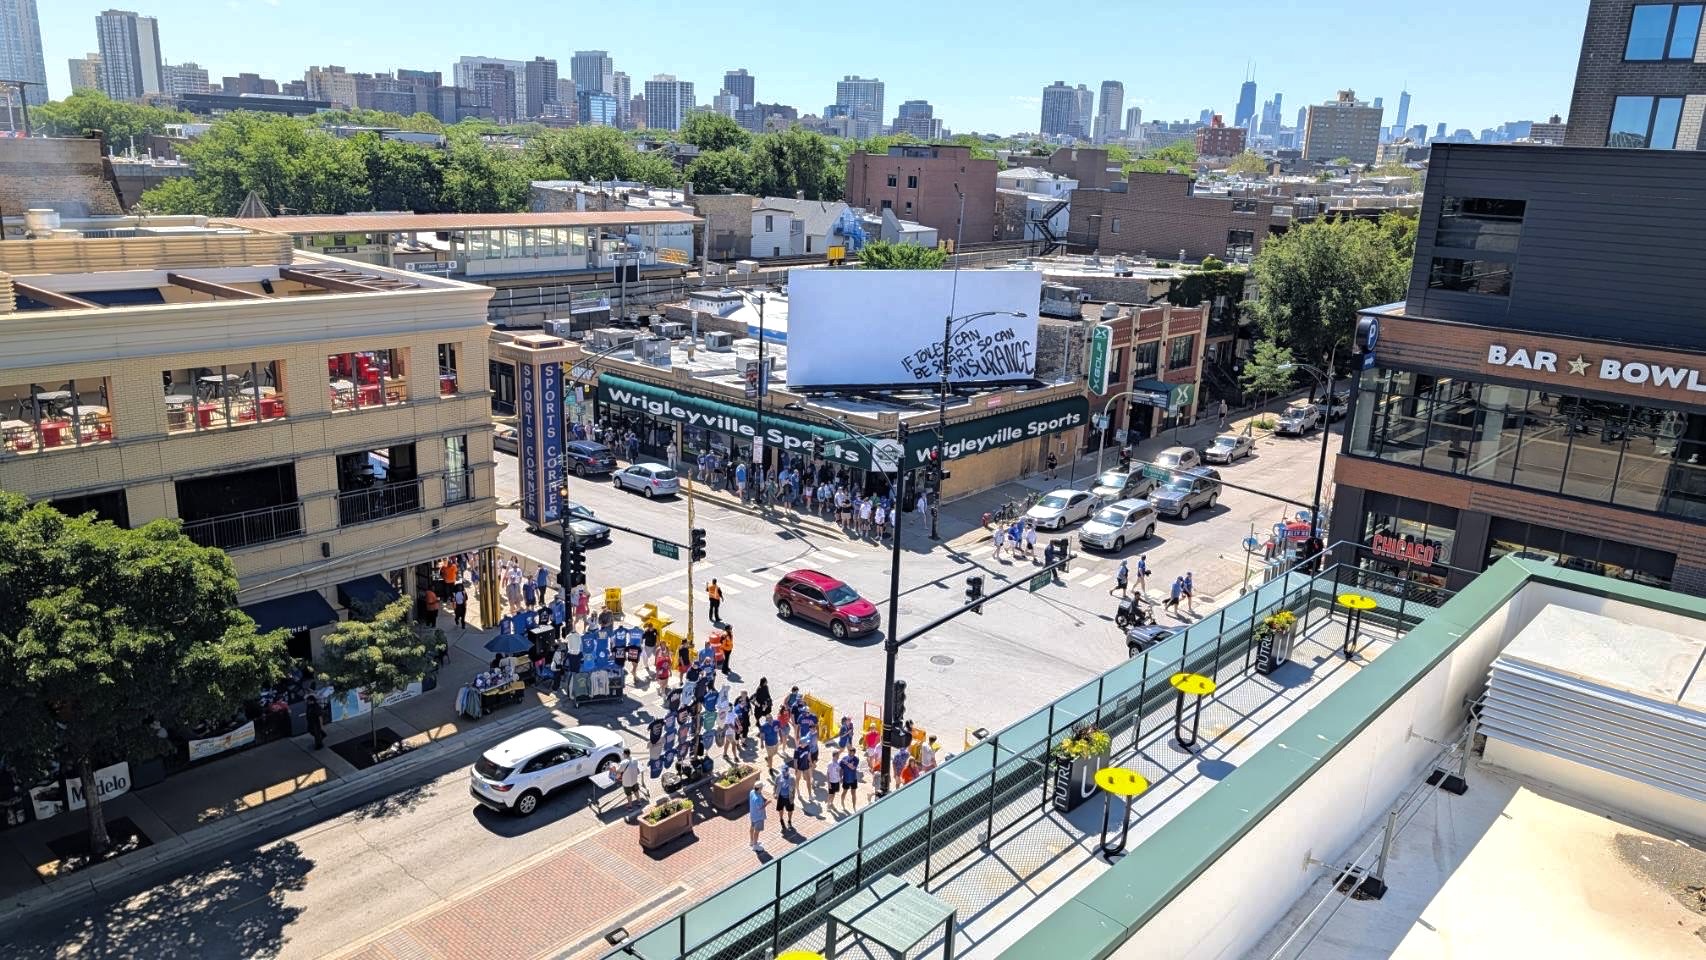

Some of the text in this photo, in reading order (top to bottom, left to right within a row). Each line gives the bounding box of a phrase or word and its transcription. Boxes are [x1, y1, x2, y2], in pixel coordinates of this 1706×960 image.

[901, 356, 914, 373] IF
[955, 329, 981, 346] CAN
[913, 365, 932, 380] BE
[977, 335, 992, 353] SO
[994, 327, 1015, 343] CAN
[954, 340, 1035, 379] INSURANCE
[1487, 344, 1558, 373] BAR
[545, 365, 556, 438] SPORTS
[608, 387, 755, 436] Wrigleyville
[767, 429, 860, 463] Spots
[523, 365, 535, 516] SPORTS CORNER
[916, 426, 1022, 463] Wigleyville
[1027, 412, 1081, 436] Sports
[1372, 533, 1435, 567] CHICAGO
[71, 775, 126, 803] Mdelo
